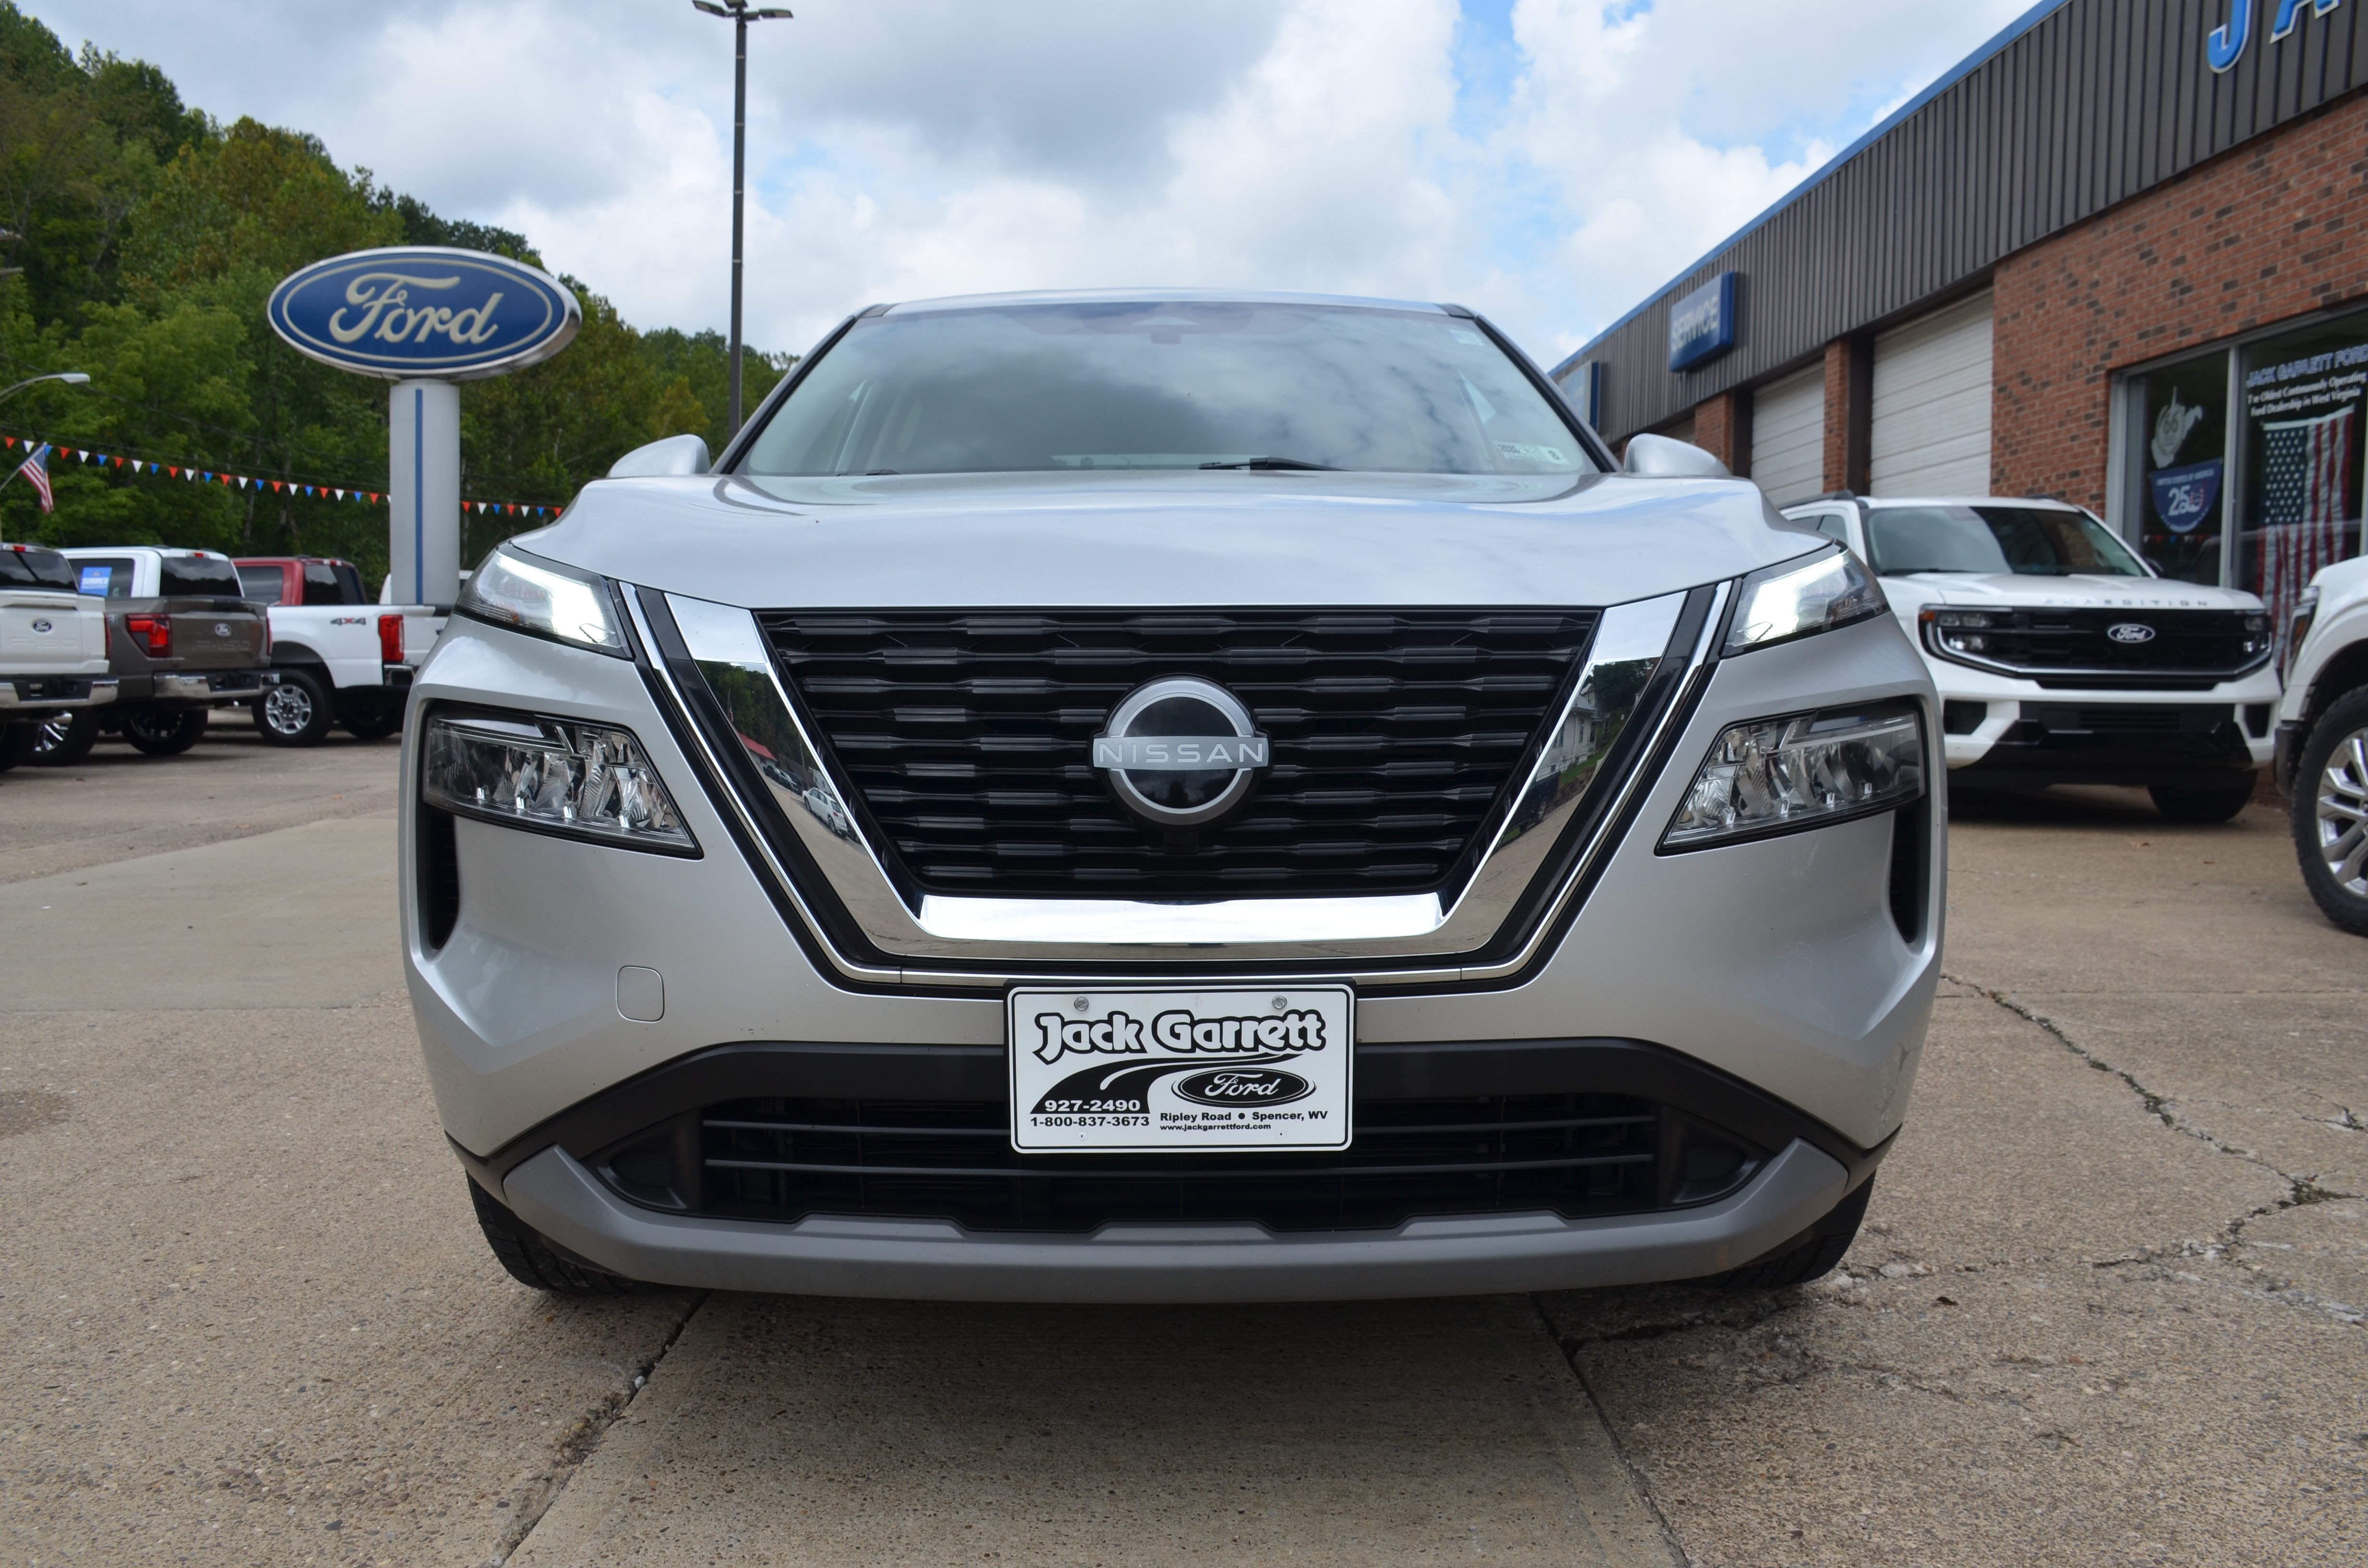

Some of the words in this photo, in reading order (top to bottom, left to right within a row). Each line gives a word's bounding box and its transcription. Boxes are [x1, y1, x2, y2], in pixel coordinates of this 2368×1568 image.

[329, 272, 504, 344] Ford
[1671, 294, 1718, 353] SERVICE
[2246, 366, 2277, 388] JACK
[2277, 352, 2334, 381] GARRETT
[2260, 389, 2282, 402] Oldest
[2282, 378, 2328, 397] Continuously
[2329, 370, 2367, 389] Operating
[2251, 406, 2267, 416] Ford
[2267, 397, 2302, 414] Dealership
[2303, 396, 2311, 406] in
[2312, 393, 2330, 405] West
[2331, 387, 2361, 402] Virginia
[2117, 626, 2147, 640] Ford
[1099, 743, 1263, 762] NISSAN
[1033, 1011, 1147, 1065] Jack
[1152, 1009, 1326, 1053] Garrett
[1205, 1073, 1279, 1096] Ford
[1045, 1100, 1140, 1112] 927-2490
[1160, 1112, 1198, 1123] Ripley
[1201, 1111, 1232, 1121] Road
[1252, 1111, 1305, 1122] Spencer,
[1308, 1111, 1328, 1120] WV
[1030, 1116, 1149, 1127] 1-800-837-3673
[1160, 1123, 1271, 1132] www.jackgarrettford.com
